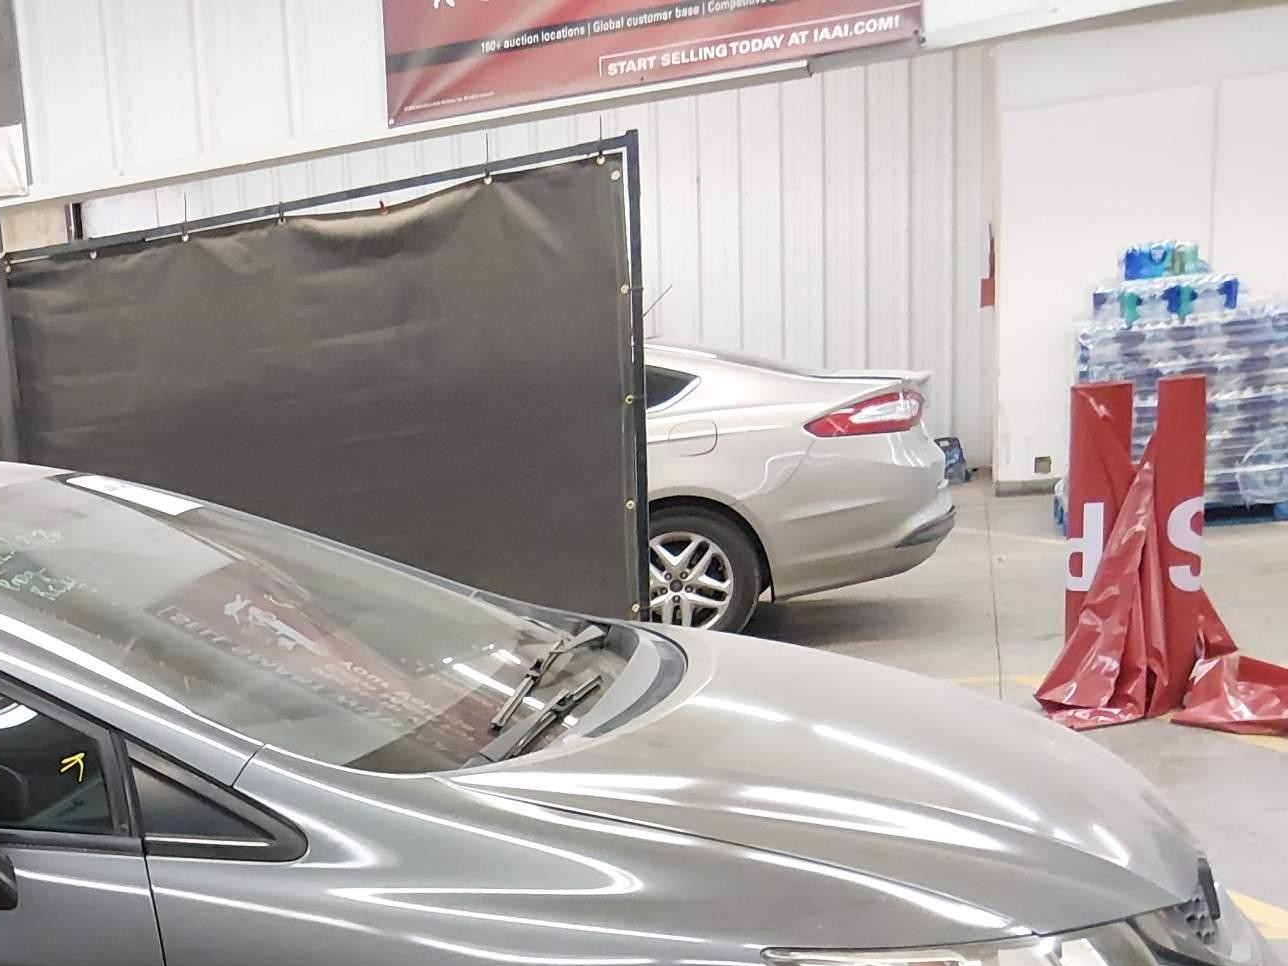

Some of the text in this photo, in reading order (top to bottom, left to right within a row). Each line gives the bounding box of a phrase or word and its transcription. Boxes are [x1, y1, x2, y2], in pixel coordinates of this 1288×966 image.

[504, 32, 539, 49] auction
[541, 24, 585, 43] locations
[593, 17, 624, 33] Global
[626, 11, 673, 28] customer
[675, 5, 700, 17] base
[607, 14, 901, 76] START SELLING TODAY AT IAAI.COM!
